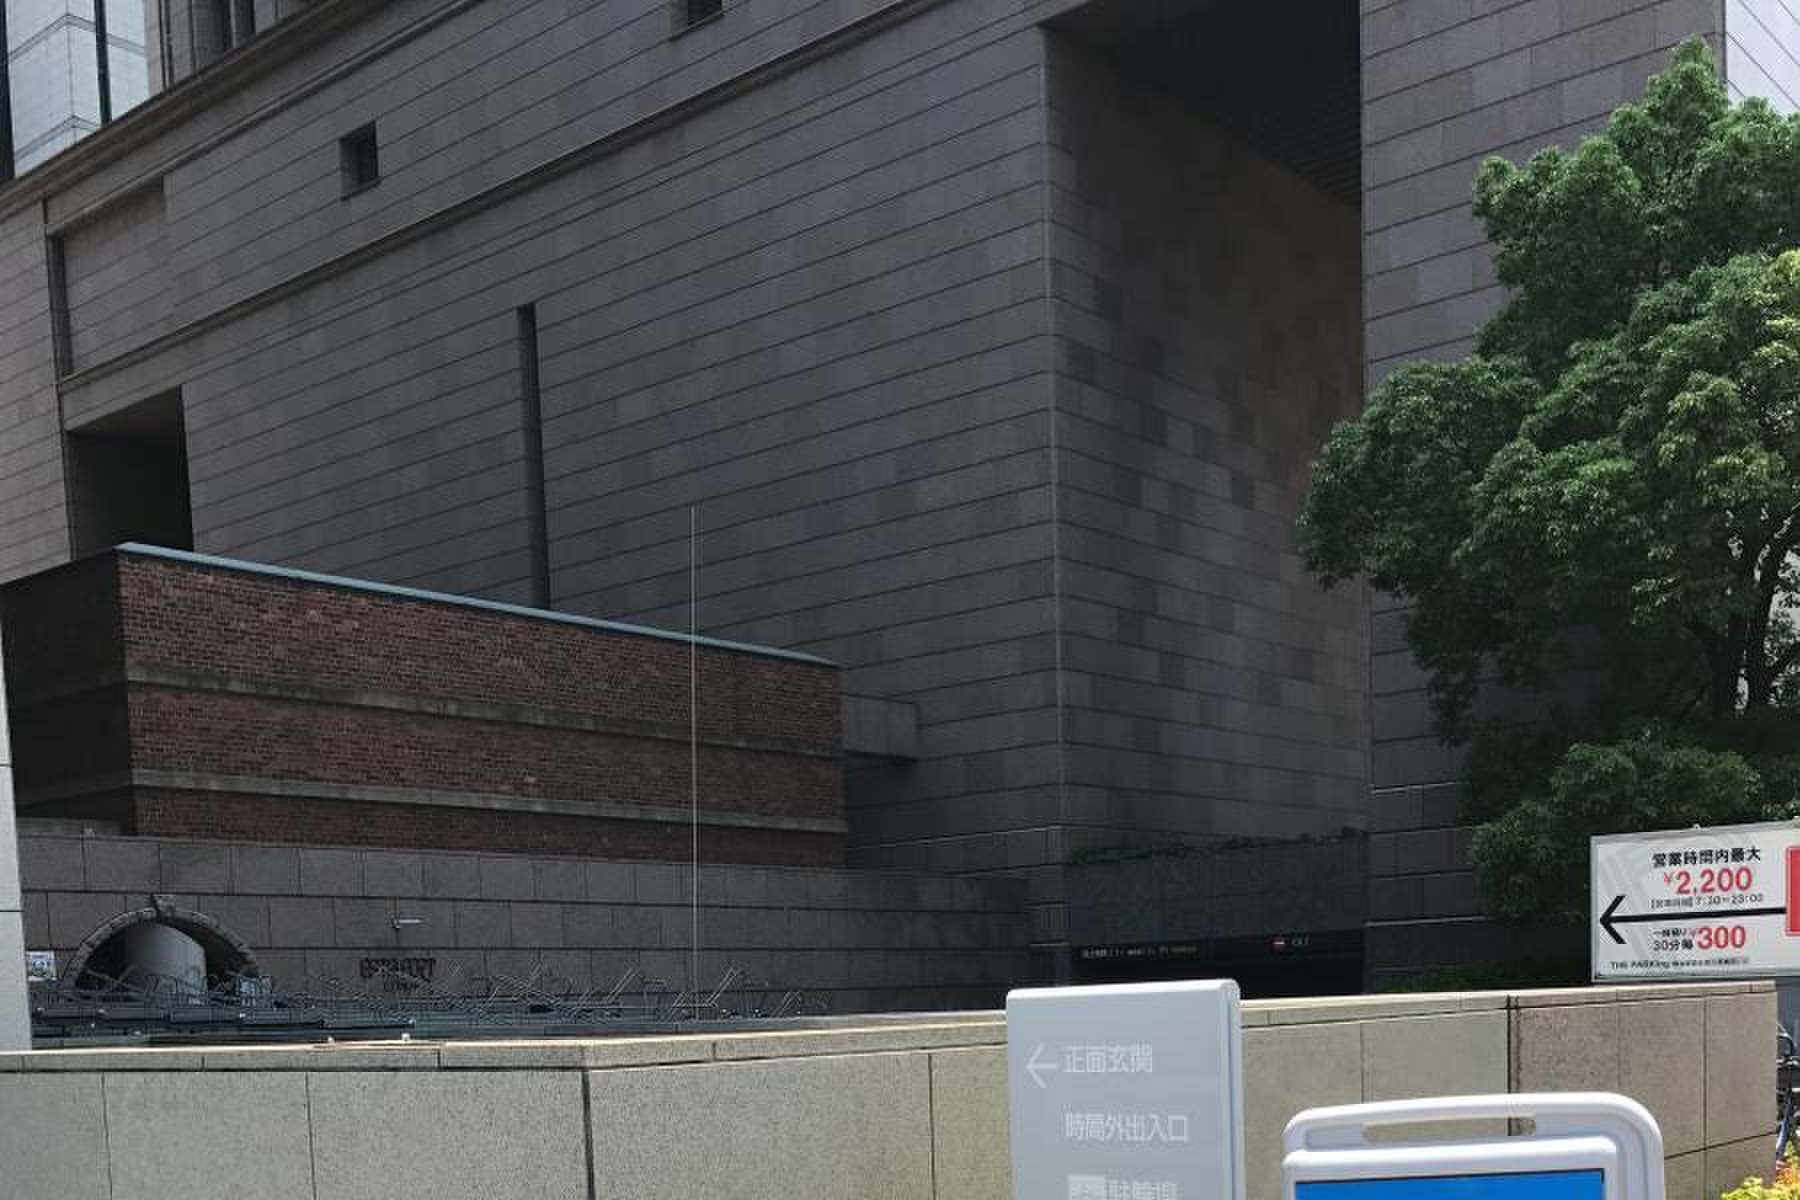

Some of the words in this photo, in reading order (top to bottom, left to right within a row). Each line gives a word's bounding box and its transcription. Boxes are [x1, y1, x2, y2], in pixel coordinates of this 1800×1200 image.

[1652, 846, 1761, 868] 営業時間内最大
[1663, 866, 1753, 895] ¥2,200
[1063, 1043, 1153, 1074] 正面玄関
[1064, 1112, 1190, 1143] 時間外出入口
